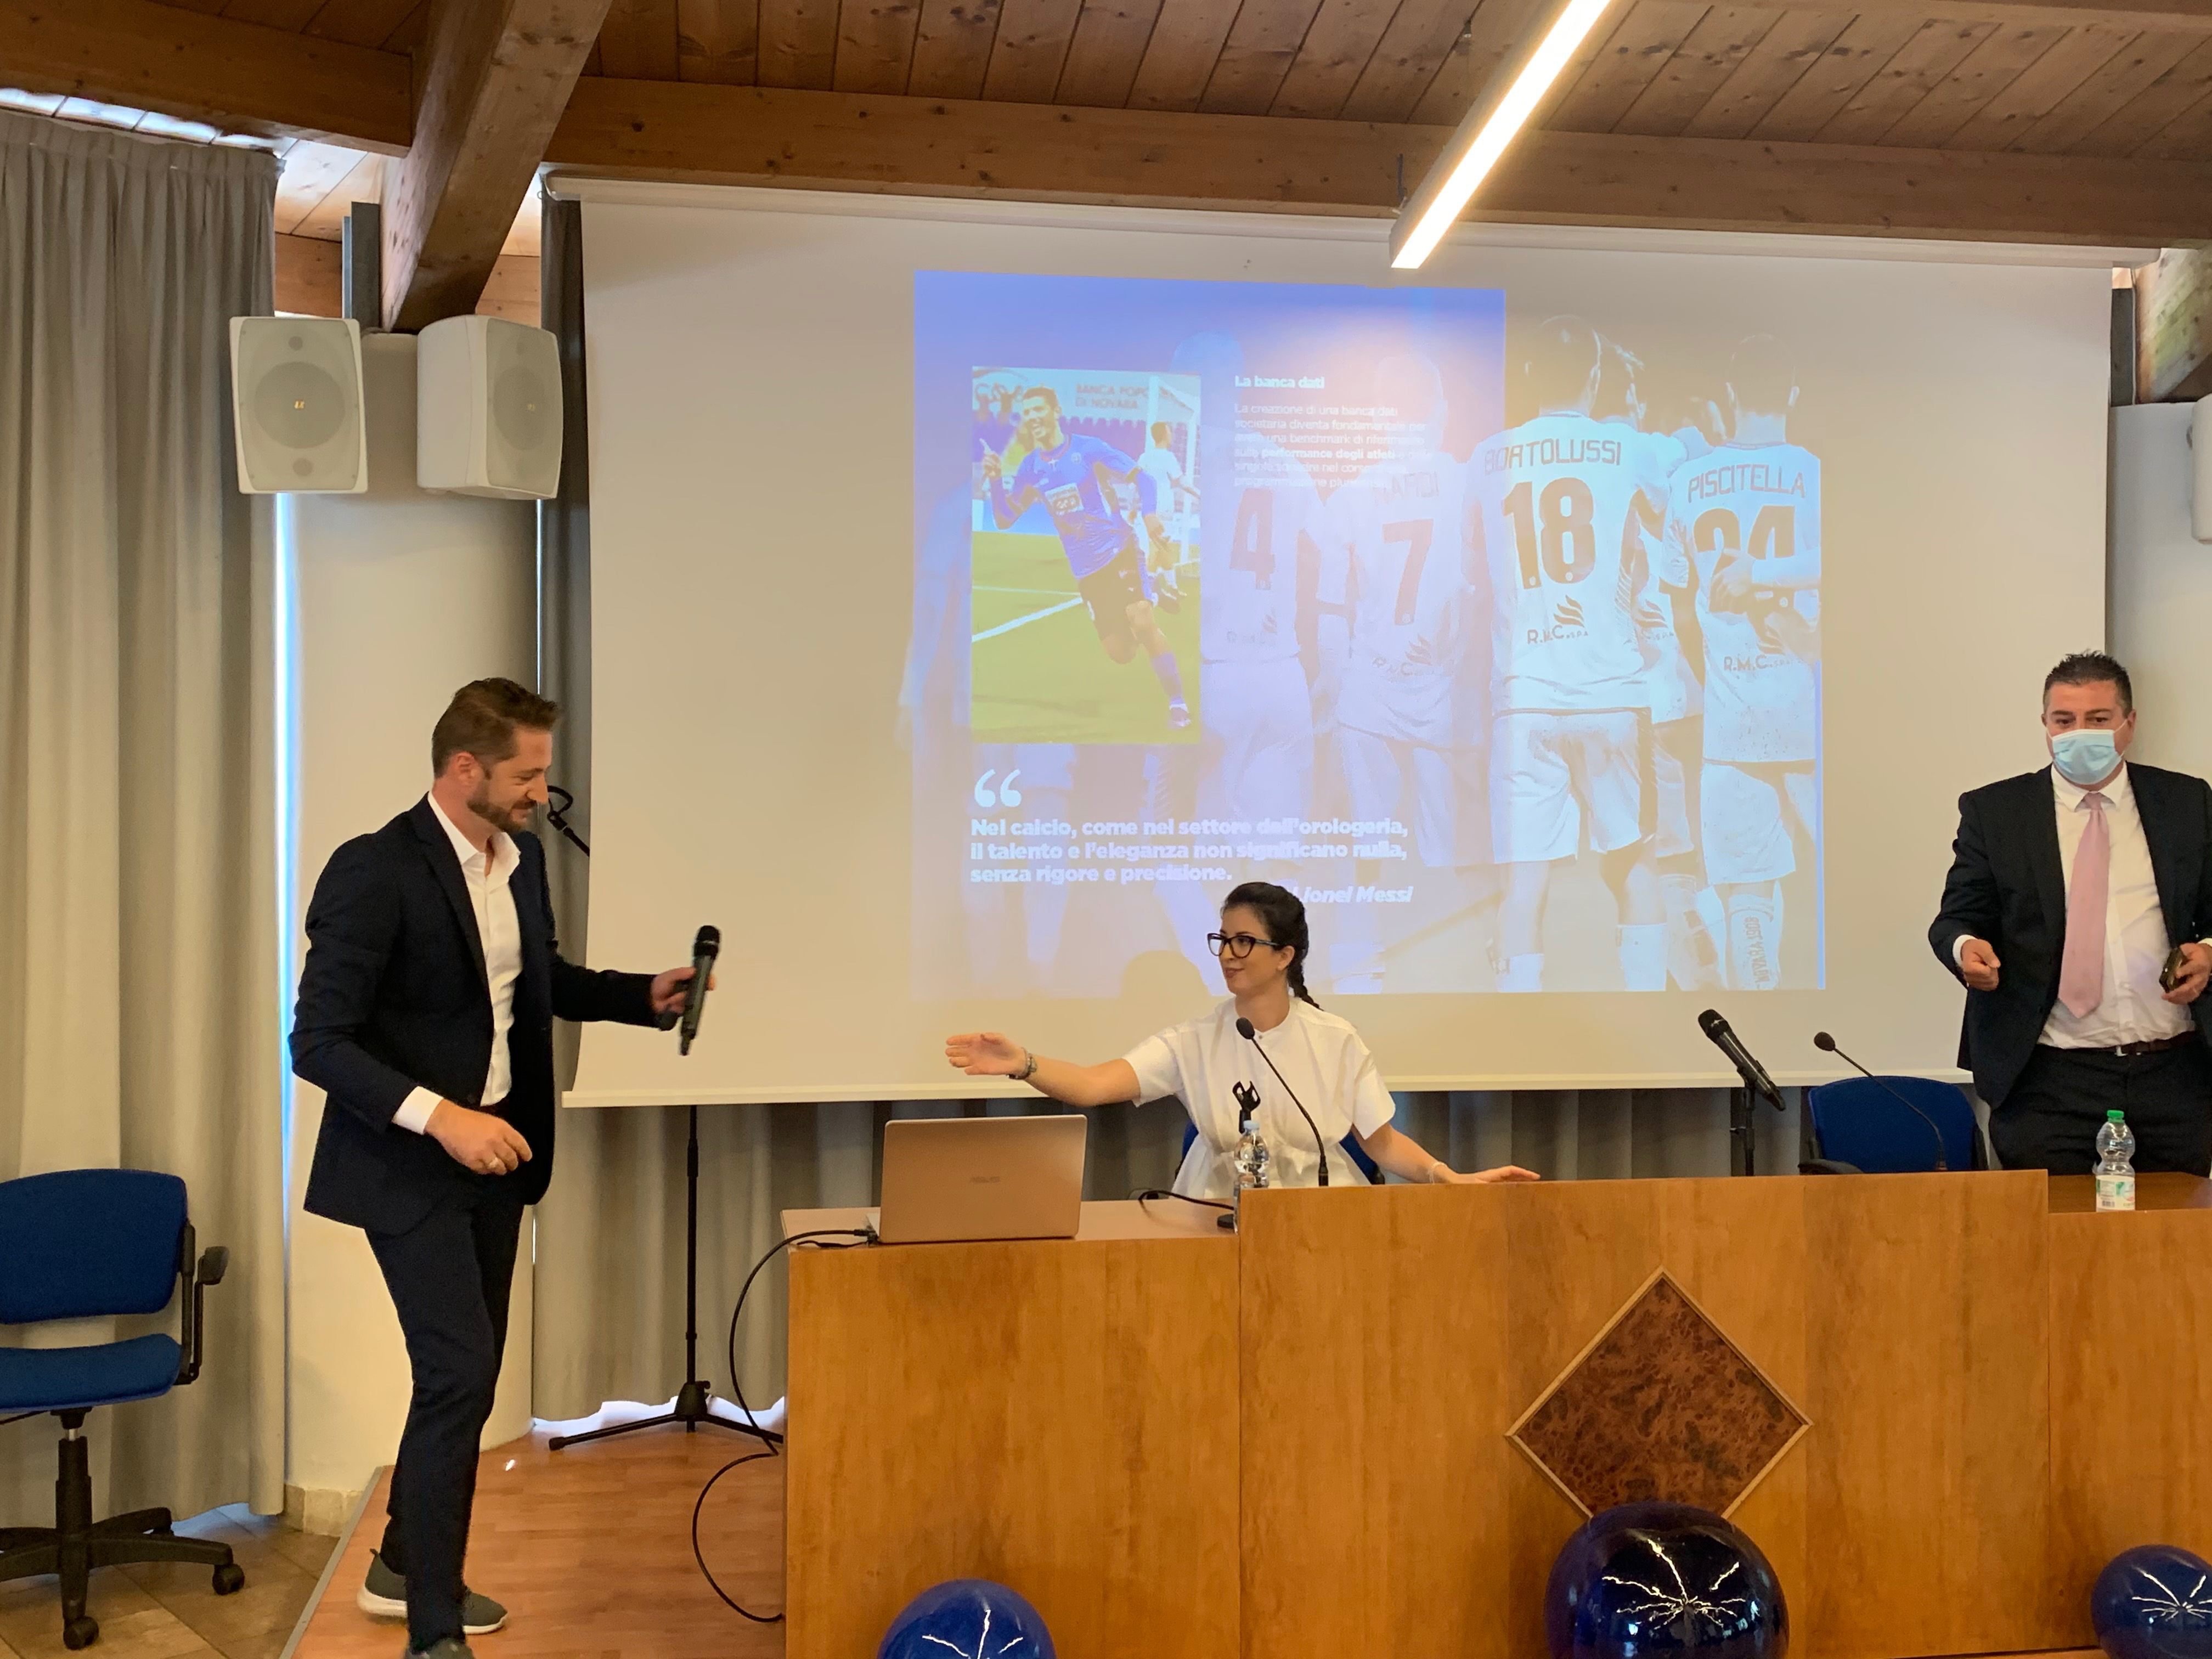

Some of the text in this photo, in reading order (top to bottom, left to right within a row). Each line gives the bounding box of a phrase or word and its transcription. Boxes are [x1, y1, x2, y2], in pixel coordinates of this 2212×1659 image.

[1235, 375, 1325, 388] La banca dati
[1250, 405, 1303, 414] creazione
[1319, 407, 1339, 415] una
[1342, 405, 1374, 416] banca
[1289, 419, 1329, 430] diventa
[1267, 435, 1286, 443] una
[1290, 433, 1351, 444] benchmark
[1261, 447, 1333, 459] performance
[1336, 448, 1364, 461] degli
[1367, 449, 1396, 459] atleti
[1688, 464, 1805, 503] PISCITELLA
[1501, 477, 1596, 589] 18
[1383, 518, 1434, 625] 7
[971, 819, 1006, 836] Nel
[1011, 819, 1077, 839] calcio,
[1082, 822, 1137, 836] come
[1143, 819, 1174, 836] nel
[1178, 819, 1251, 834] settore
[970, 840, 1407, 861] il talento e l'eleganza non significano nulla,
[970, 864, 1233, 885] senza rigore e precisione.
[1356, 885, 1414, 903] Messi
